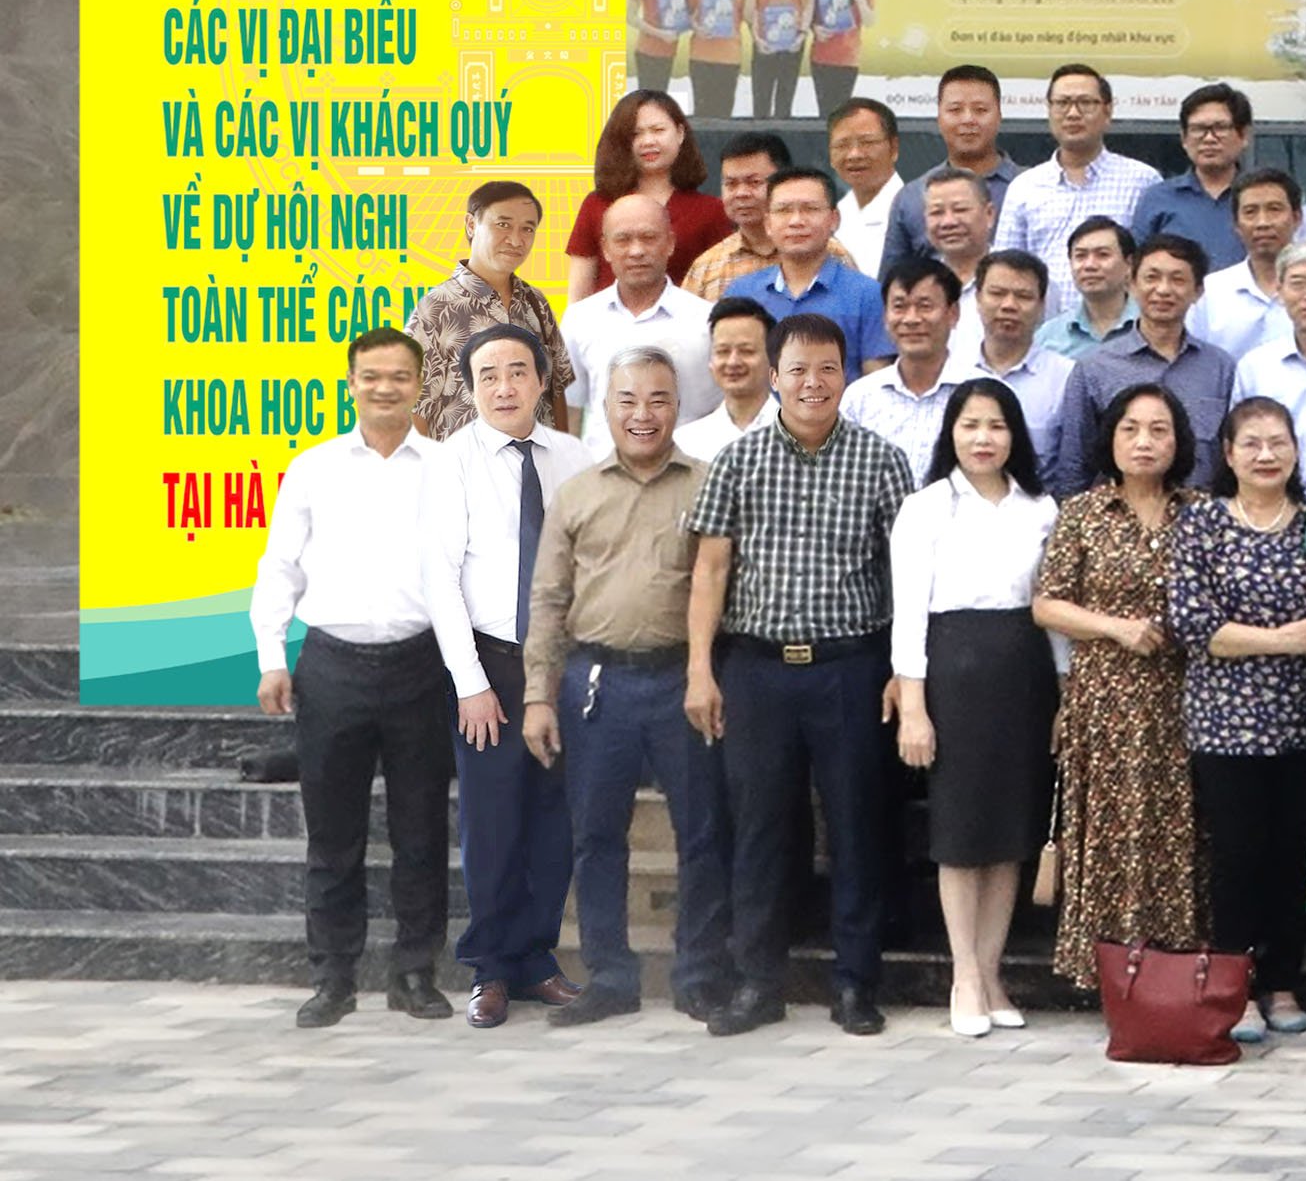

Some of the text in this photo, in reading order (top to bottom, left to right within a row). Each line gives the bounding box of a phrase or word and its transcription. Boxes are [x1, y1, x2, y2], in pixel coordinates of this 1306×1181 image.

[238, 8, 268, 78] VỊ
[278, 8, 332, 78] ĐẠI
[162, 88, 204, 158] VÀ
[215, 88, 279, 158] CÁC
[289, 101, 319, 171] VỊ
[331, 88, 439, 158] KHÁCH
[450, 88, 513, 165] QUÝ
[162, 172, 408, 263] VỀ DỰ HỘI NGHỊ
[162, 274, 247, 343] TOÀN
[257, 262, 318, 343] THỂ
[328, 274, 392, 343] CÁC
[163, 378, 250, 436] KHOA
[261, 378, 325, 449] HỌC
[162, 459, 267, 542] TẠI HÀ
